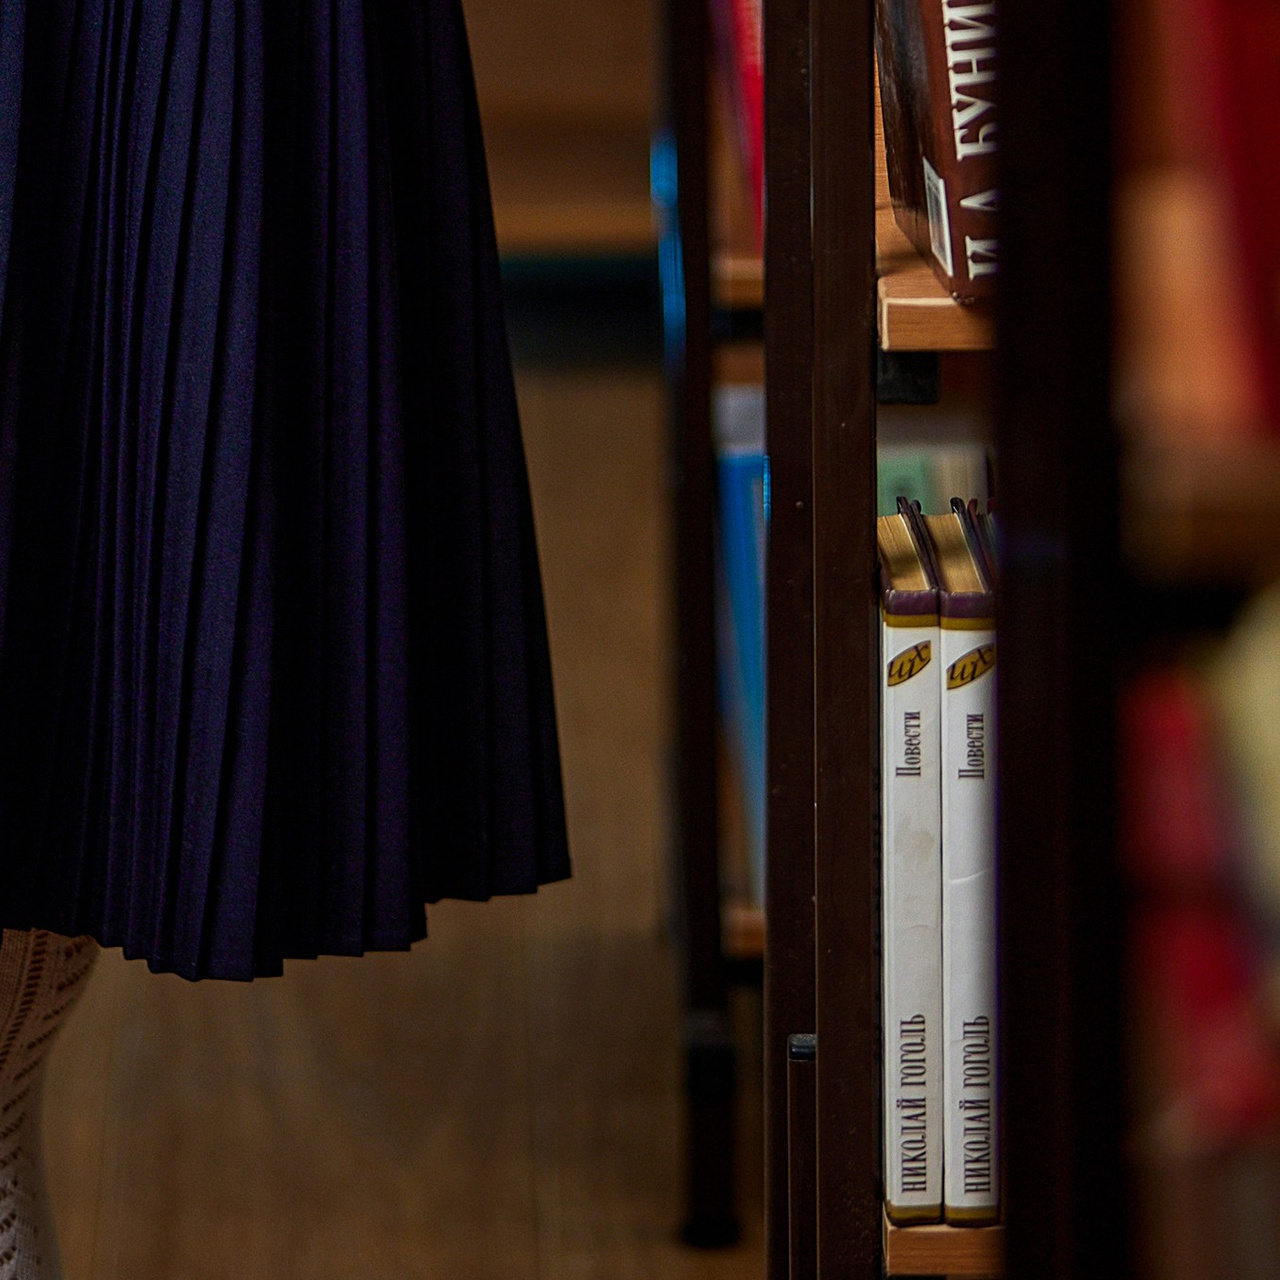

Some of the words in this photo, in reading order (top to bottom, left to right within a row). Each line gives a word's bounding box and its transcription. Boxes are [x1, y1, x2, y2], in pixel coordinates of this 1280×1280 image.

[895, 711, 922, 778] Повести
[957, 713, 985, 780] Повести
[899, 1013, 927, 1088] ГОГОЛЬ
[962, 1014, 991, 1089] ГОГОЛЬ
[896, 1097, 928, 1194] НИКОЛАЙ
[958, 1097, 992, 1195] НИКОЛАЙ
